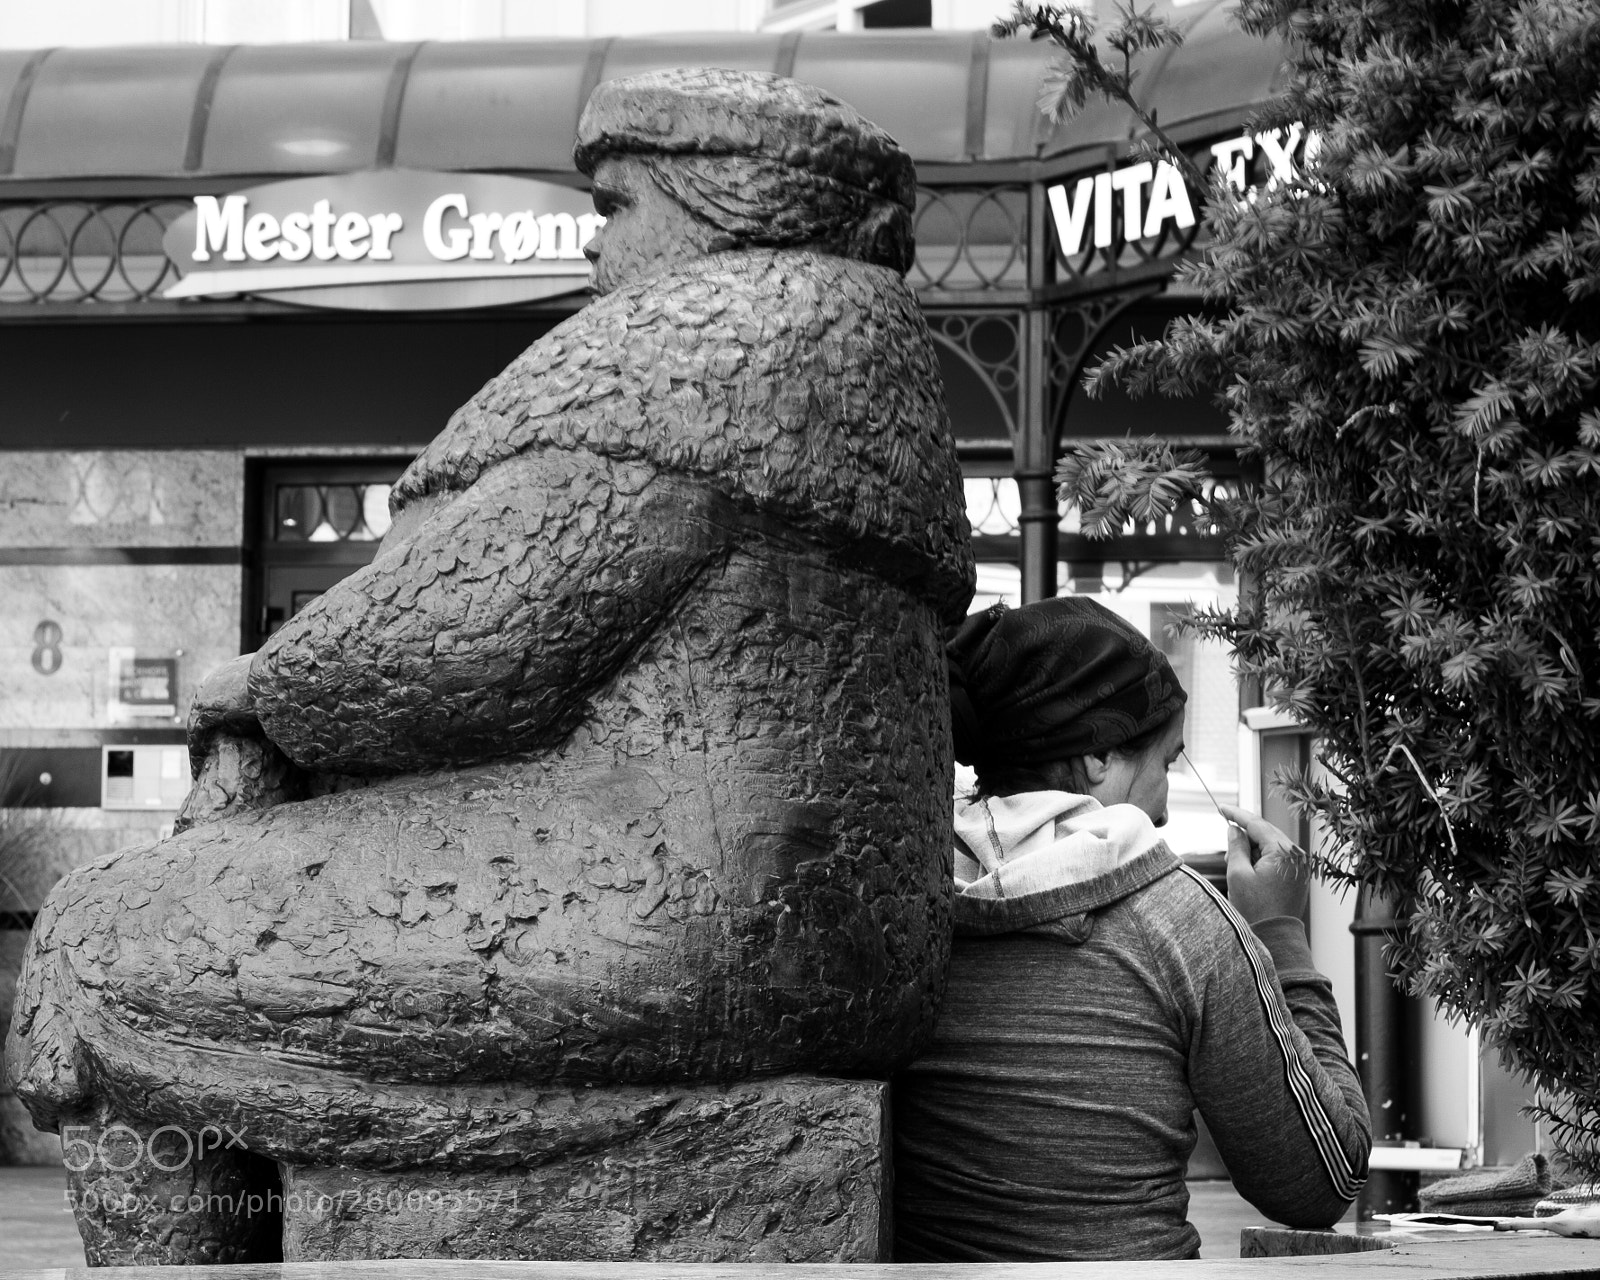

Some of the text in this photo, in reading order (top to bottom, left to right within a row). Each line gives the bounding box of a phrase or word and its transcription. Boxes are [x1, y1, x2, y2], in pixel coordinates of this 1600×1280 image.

[191, 195, 403, 262] Mester
[1047, 159, 1196, 257] VITA
[31, 619, 63, 676] 8
